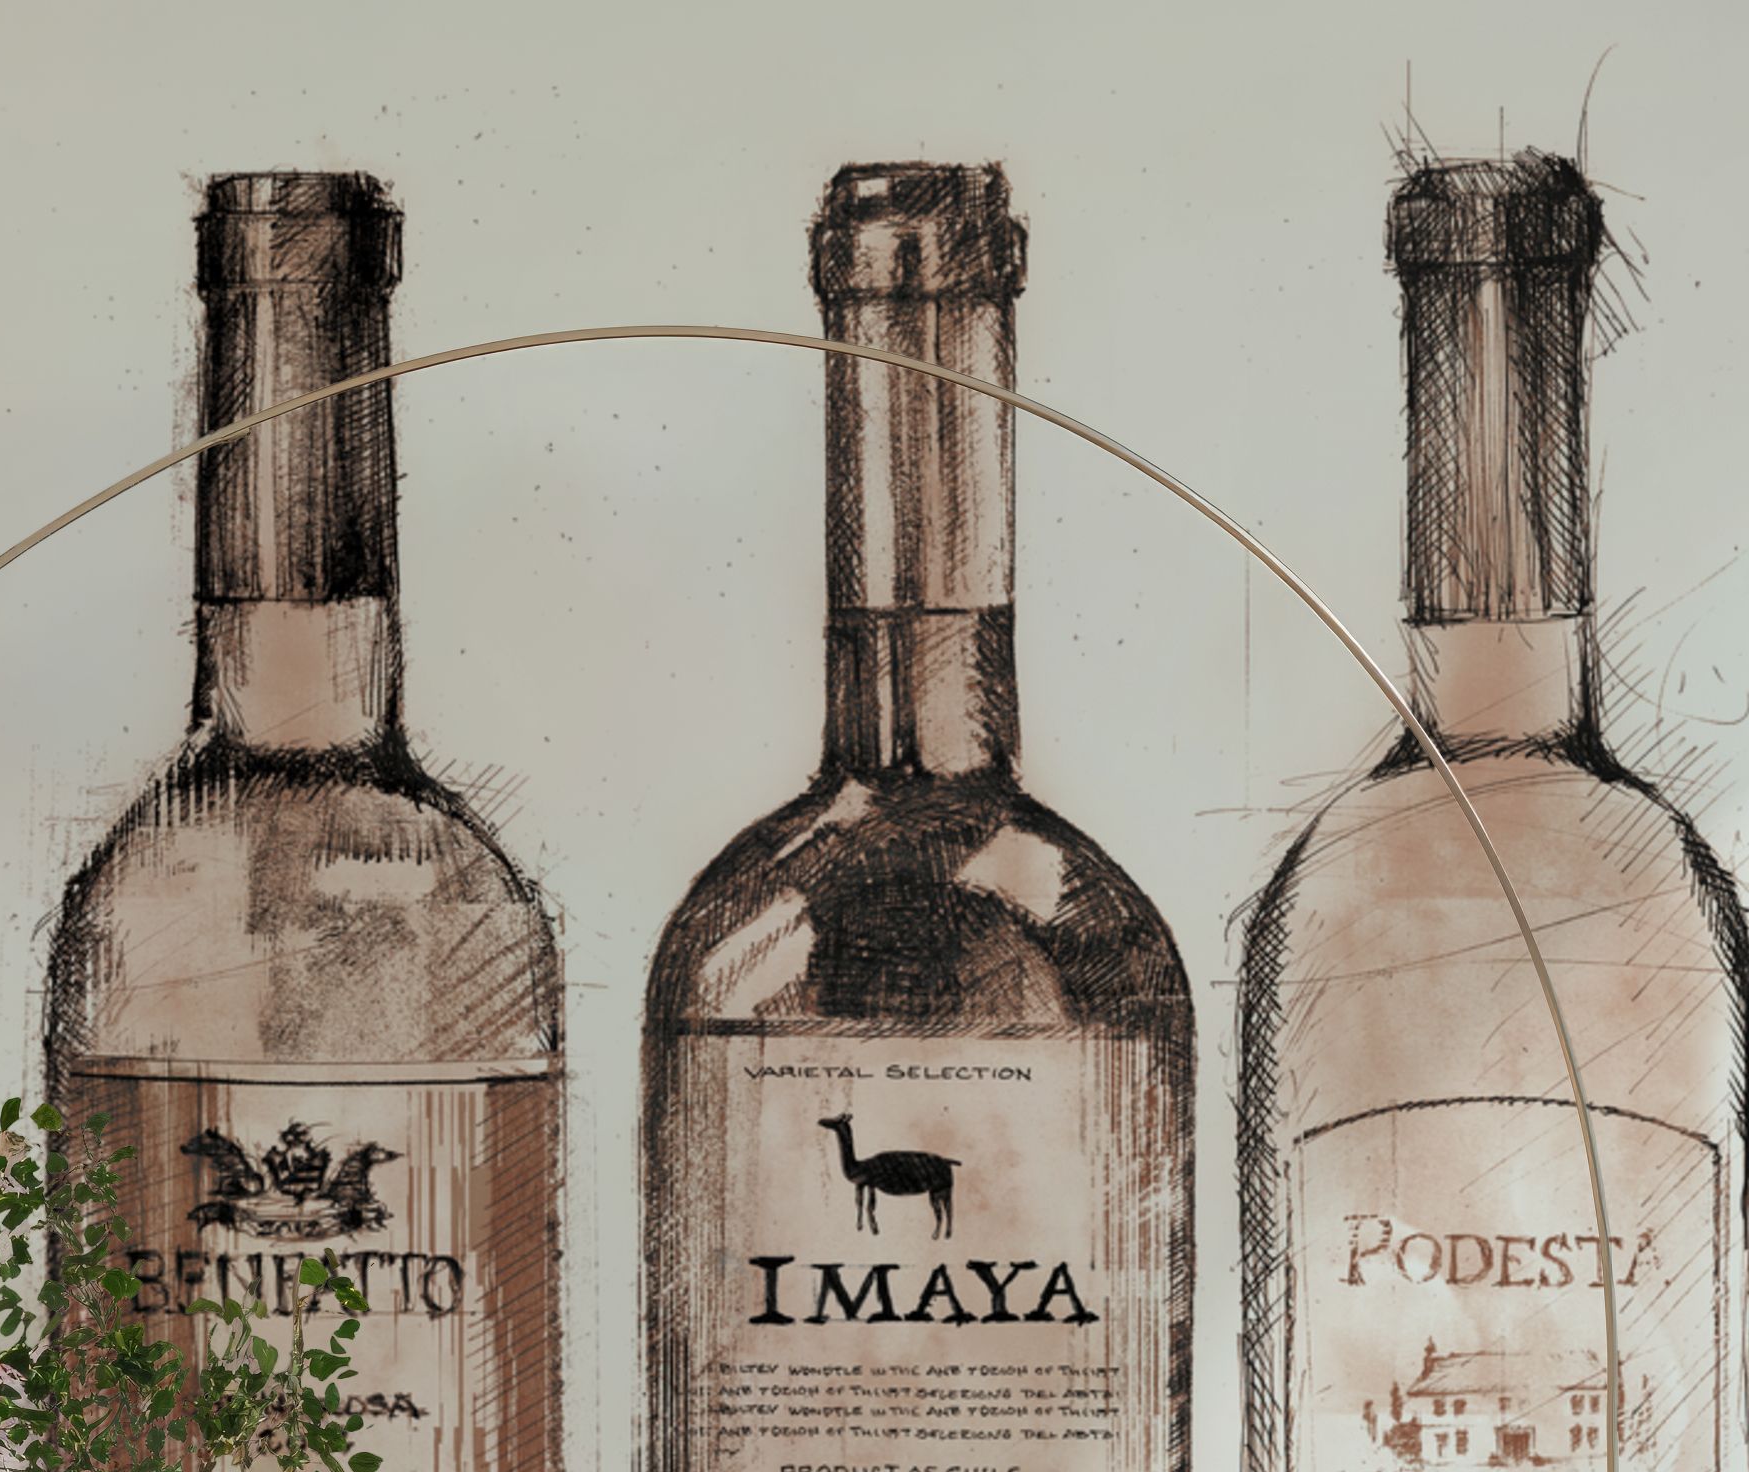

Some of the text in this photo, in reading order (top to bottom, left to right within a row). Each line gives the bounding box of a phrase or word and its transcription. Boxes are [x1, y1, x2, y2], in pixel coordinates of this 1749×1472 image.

[743, 1064, 1032, 1081] VARIETAL SELECTION
[748, 1255, 1100, 1326] IMAYA
